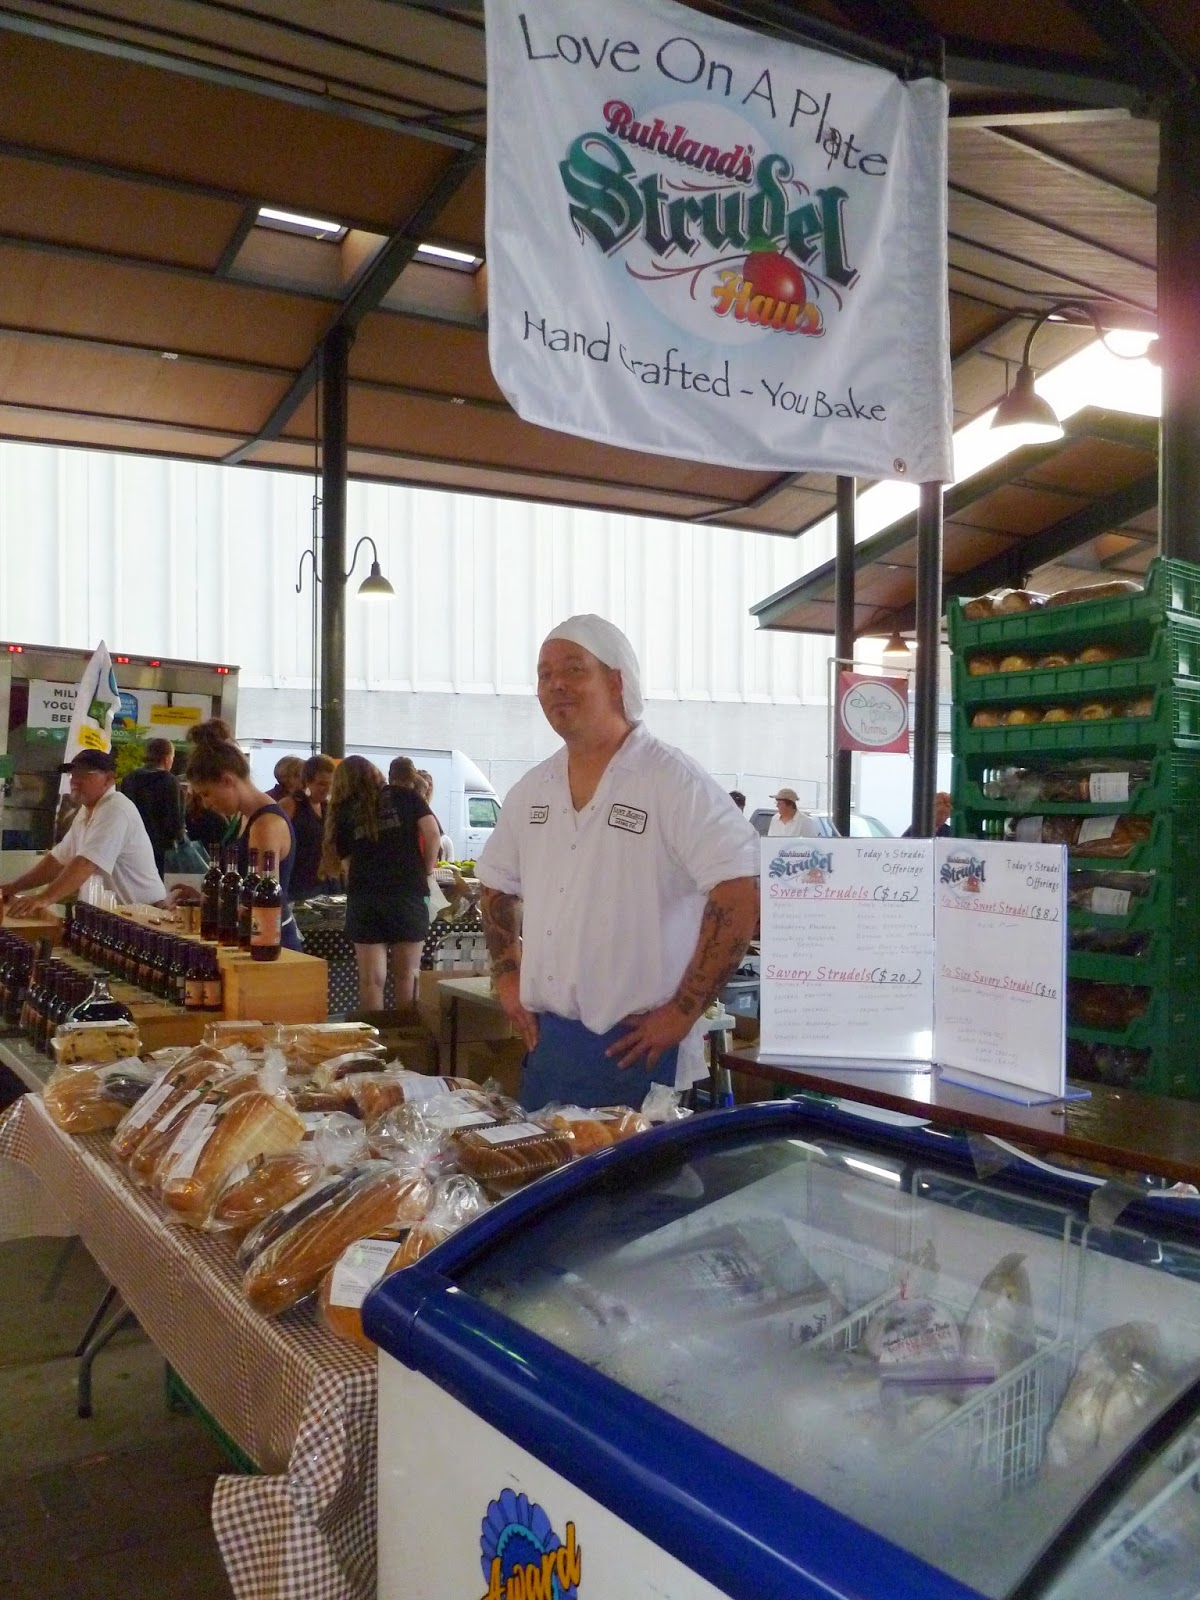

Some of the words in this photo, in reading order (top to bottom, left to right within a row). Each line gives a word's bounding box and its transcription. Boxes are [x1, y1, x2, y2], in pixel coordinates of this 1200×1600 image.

[519, 14, 640, 73] Love
[655, 37, 734, 96] On
[742, 69, 777, 119] A
[788, 89, 888, 177] Plate
[602, 99, 757, 184] Ruhland's
[559, 131, 861, 289] Strudel
[712, 270, 826, 338] Haus
[522, 311, 612, 363] Hand
[761, 379, 811, 415] You
[812, 387, 888, 422] Bake
[768, 850, 834, 878] Strudel
[856, 849, 890, 861] Today's
[893, 849, 925, 859] Strudel
[1006, 859, 1032, 873] Today's
[1035, 861, 1060, 873] Strudel
[882, 863, 924, 877] Offerings
[940, 857, 986, 884] Strudel
[769, 884, 809, 898] Sweet
[813, 884, 869, 899] Strudels
[1026, 876, 1060, 893] Offerings
[955, 898, 971, 909] Size
[973, 899, 997, 913] Sweet
[999, 901, 1029, 917] Strudel
[765, 965, 811, 984] Savory
[817, 966, 871, 982] Strudels
[955, 967, 971, 980] Size
[975, 970, 1001, 988] Savory
[1003, 976, 1033, 993] Strudel
